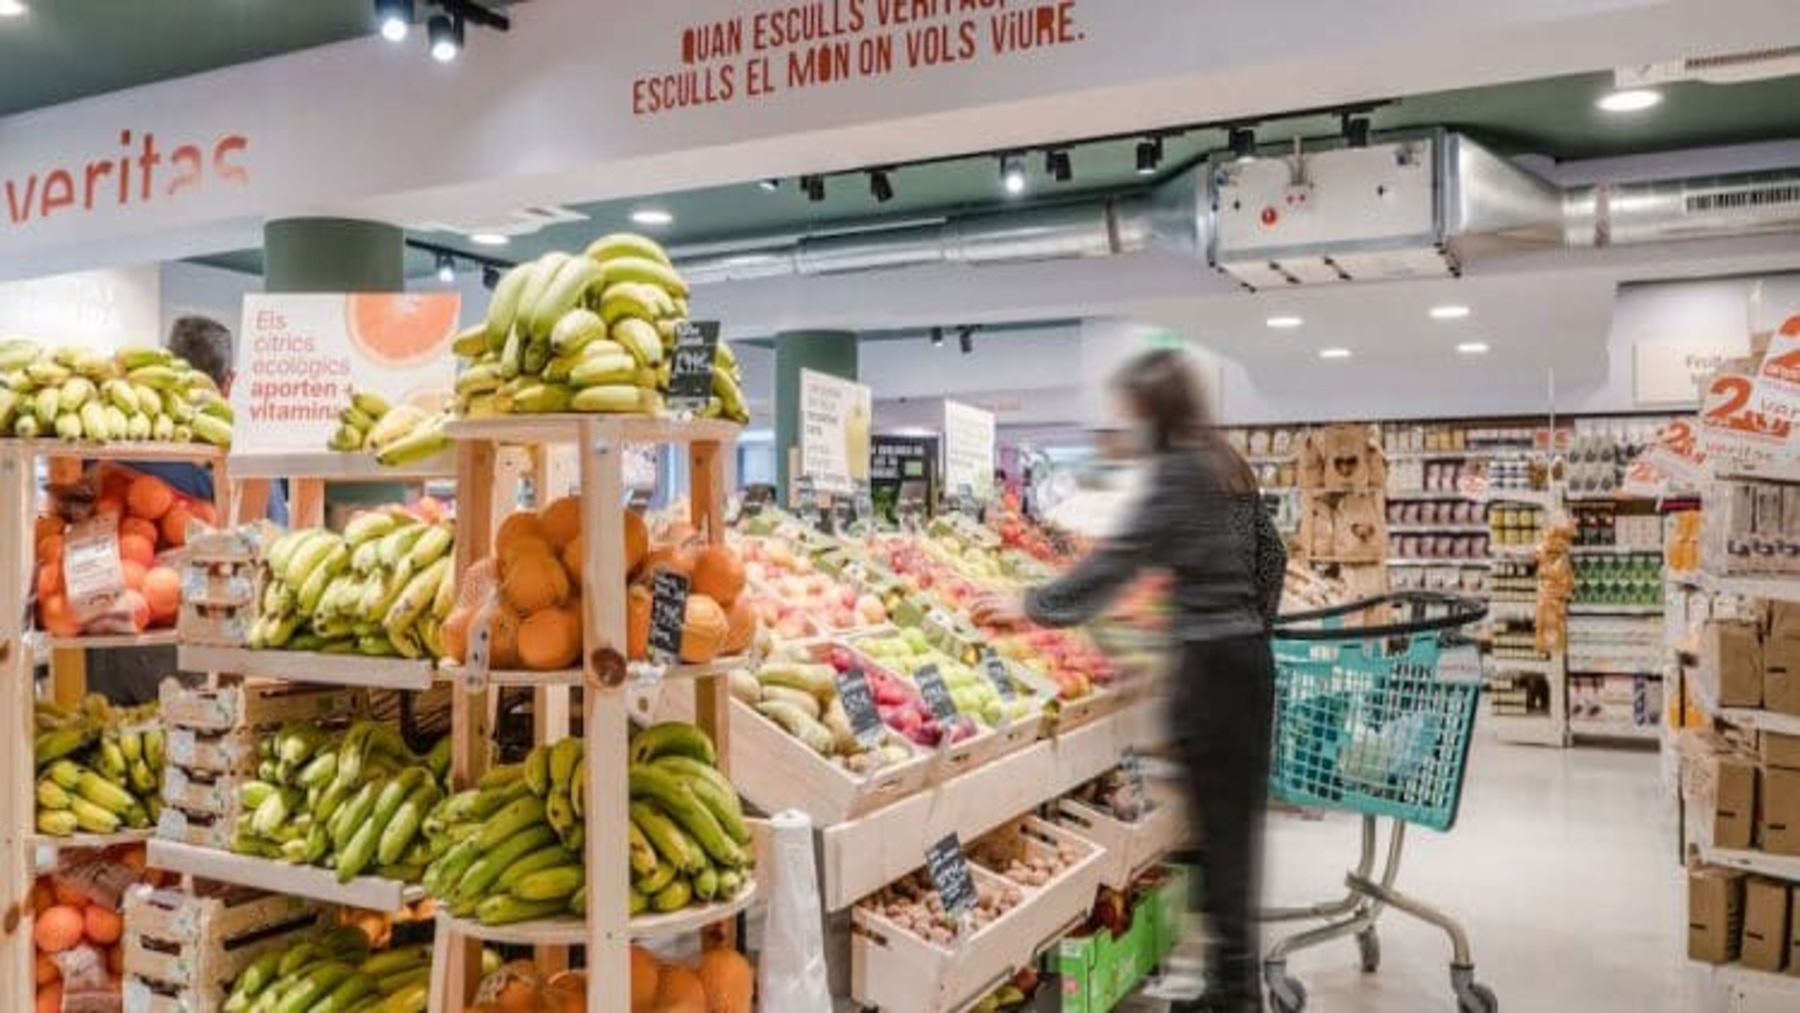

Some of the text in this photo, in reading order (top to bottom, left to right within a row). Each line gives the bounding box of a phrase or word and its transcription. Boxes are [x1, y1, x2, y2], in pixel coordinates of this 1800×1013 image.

[683, 20, 742, 64] QUAN
[753, 3, 864, 50] ESCULLS
[633, 65, 734, 115] ESCULLS
[746, 57, 775, 95] EL
[859, 36, 892, 75] ON
[906, 21, 977, 68] VOLS
[5, 129, 249, 222] veritas
[257, 311, 287, 330] Els
[251, 379, 337, 402] aporten
